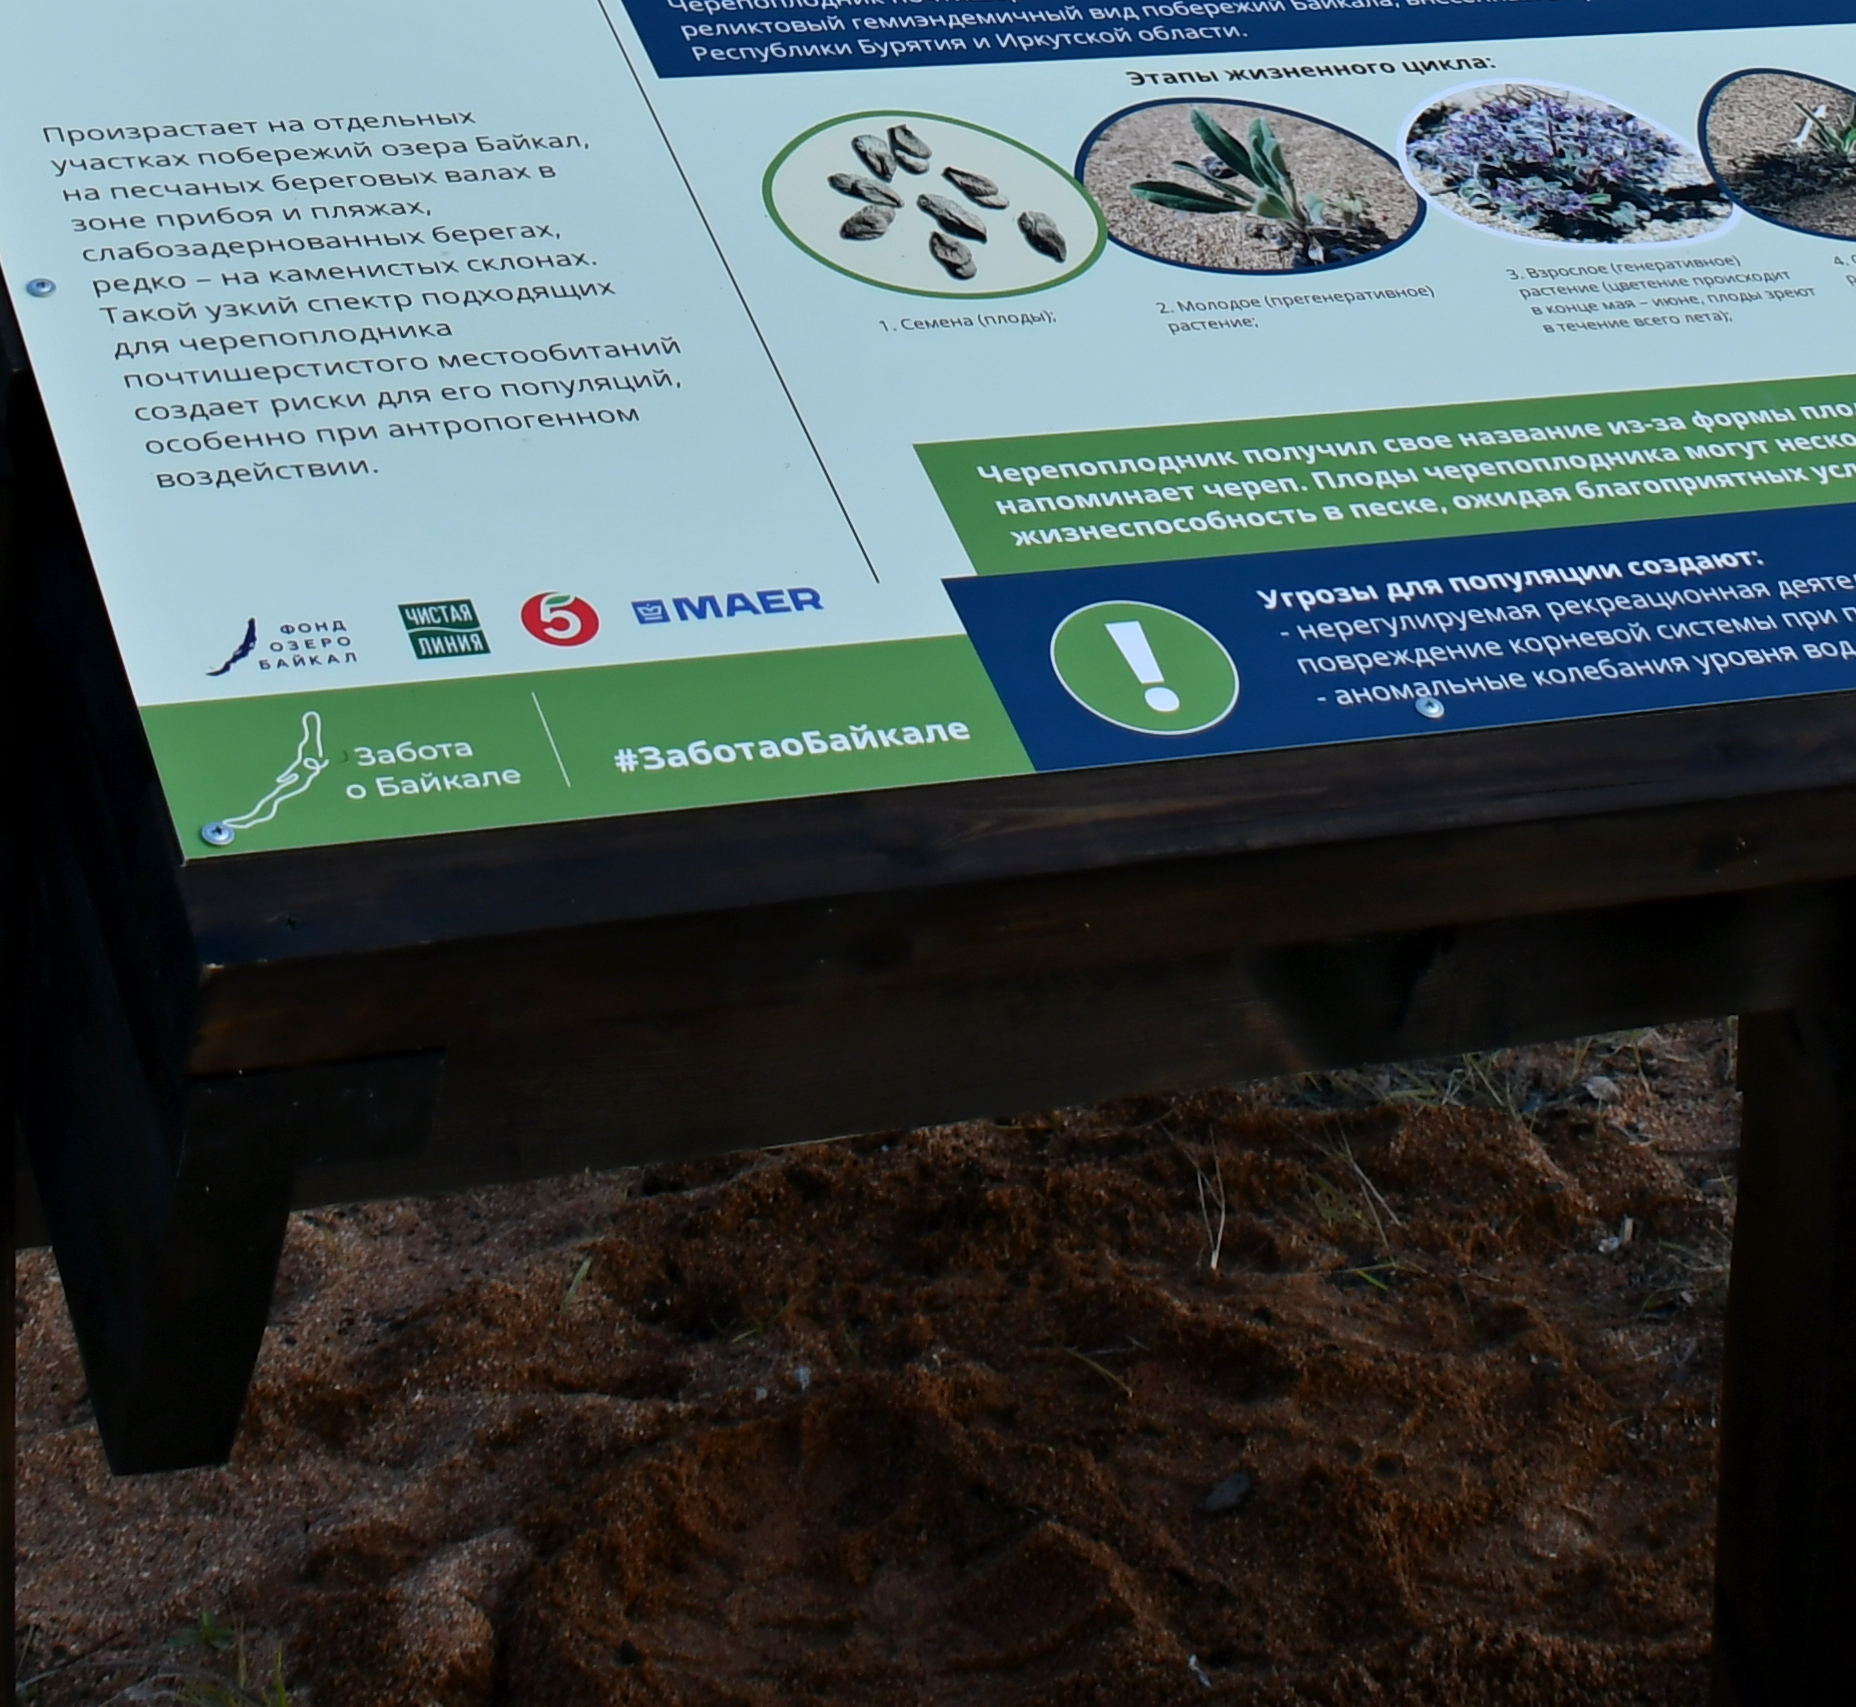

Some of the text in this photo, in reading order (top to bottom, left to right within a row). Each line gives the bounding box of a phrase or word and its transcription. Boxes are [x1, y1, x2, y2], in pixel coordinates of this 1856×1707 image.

[679, 14, 847, 42] реликтовый
[850, 4, 1085, 31] гемиэндемичный
[1087, 5, 1142, 23] вид
[690, 24, 1249, 64] Республики Бурятия Иркутской области.
[1124, 56, 1497, 87] Этапы жизненного цикла:
[41, 110, 477, 148] Произрастает отдельных
[50, 132, 590, 178] участках побережий озера Байкал,
[109, 166, 532, 200] песчаных береговых валах
[70, 200, 432, 233] зоне прибоя пляжах,
[81, 224, 561, 263] слабозадернованных берегах,
[91, 252, 598, 299] редко каменистых склонах.
[1519, 271, 1790, 301] растение (цветение происходит
[1525, 255, 1741, 281] Взрослое (генеративное)
[98, 281, 616, 325] Такой узкий спектр подходящих
[1176, 285, 1435, 312] Молодое (прегенеративное)
[1545, 302, 1599, 314] конце
[1602, 299, 1636, 310] мая
[1706, 291, 1763, 303] плоды
[1764, 287, 1815, 302] зреют
[178, 322, 454, 356] черепоплодника
[900, 317, 974, 331] Семена
[1556, 319, 1630, 332] течение
[1632, 315, 1681, 327] всего
[123, 335, 682, 390] почтишерстистого местообитаний
[133, 367, 682, 423] создает риски популяций,
[144, 407, 641, 456] особенно антропогенном
[975, 450, 1240, 488] Черепоплодник
[1241, 439, 1379, 466] получил
[1382, 433, 1454, 454] свое
[1456, 422, 1604, 448] название
[1605, 415, 1688, 436] из-за
[1690, 407, 1798, 434] формы
[155, 458, 379, 490] воздействии.
[994, 484, 1195, 516] напоминает
[1201, 476, 1309, 502] череп.
[1309, 467, 1420, 491] Плоды
[1421, 446, 1682, 484] черепоплодника
[1682, 439, 1770, 462] могут
[1009, 507, 1319, 548] жизнеспособность
[1347, 497, 1449, 520] песке,
[1451, 486, 1573, 511] ожидая
[1574, 466, 1811, 501] благоприятных
[1255, 549, 1765, 613] Угрозы для популяции создают:
[405, 603, 474, 626] ЧИСТАЯ
[540, 593, 582, 639] 5
[671, 586, 825, 623] MAER
[1295, 602, 1543, 644] нерегулируемая
[1544, 581, 1772, 623] рекреационная
[268, 635, 352, 653] ОЗЕРО
[278, 619, 348, 636] ФОНД
[417, 633, 485, 656] ЛИНИЯ
[1295, 639, 1505, 676] повреждение
[1507, 621, 1653, 658] корневой
[1655, 613, 1779, 641] системы
[1780, 607, 1839, 633] при
[258, 651, 358, 671] БАЙКАЛ
[1334, 671, 1528, 707] аномальные
[1530, 655, 1691, 687] колебания
[1690, 645, 1800, 676] уровня
[353, 740, 474, 768] Забота
[613, 721, 972, 774] #ЗаботаоБайкале
[374, 768, 522, 798] Байкале
